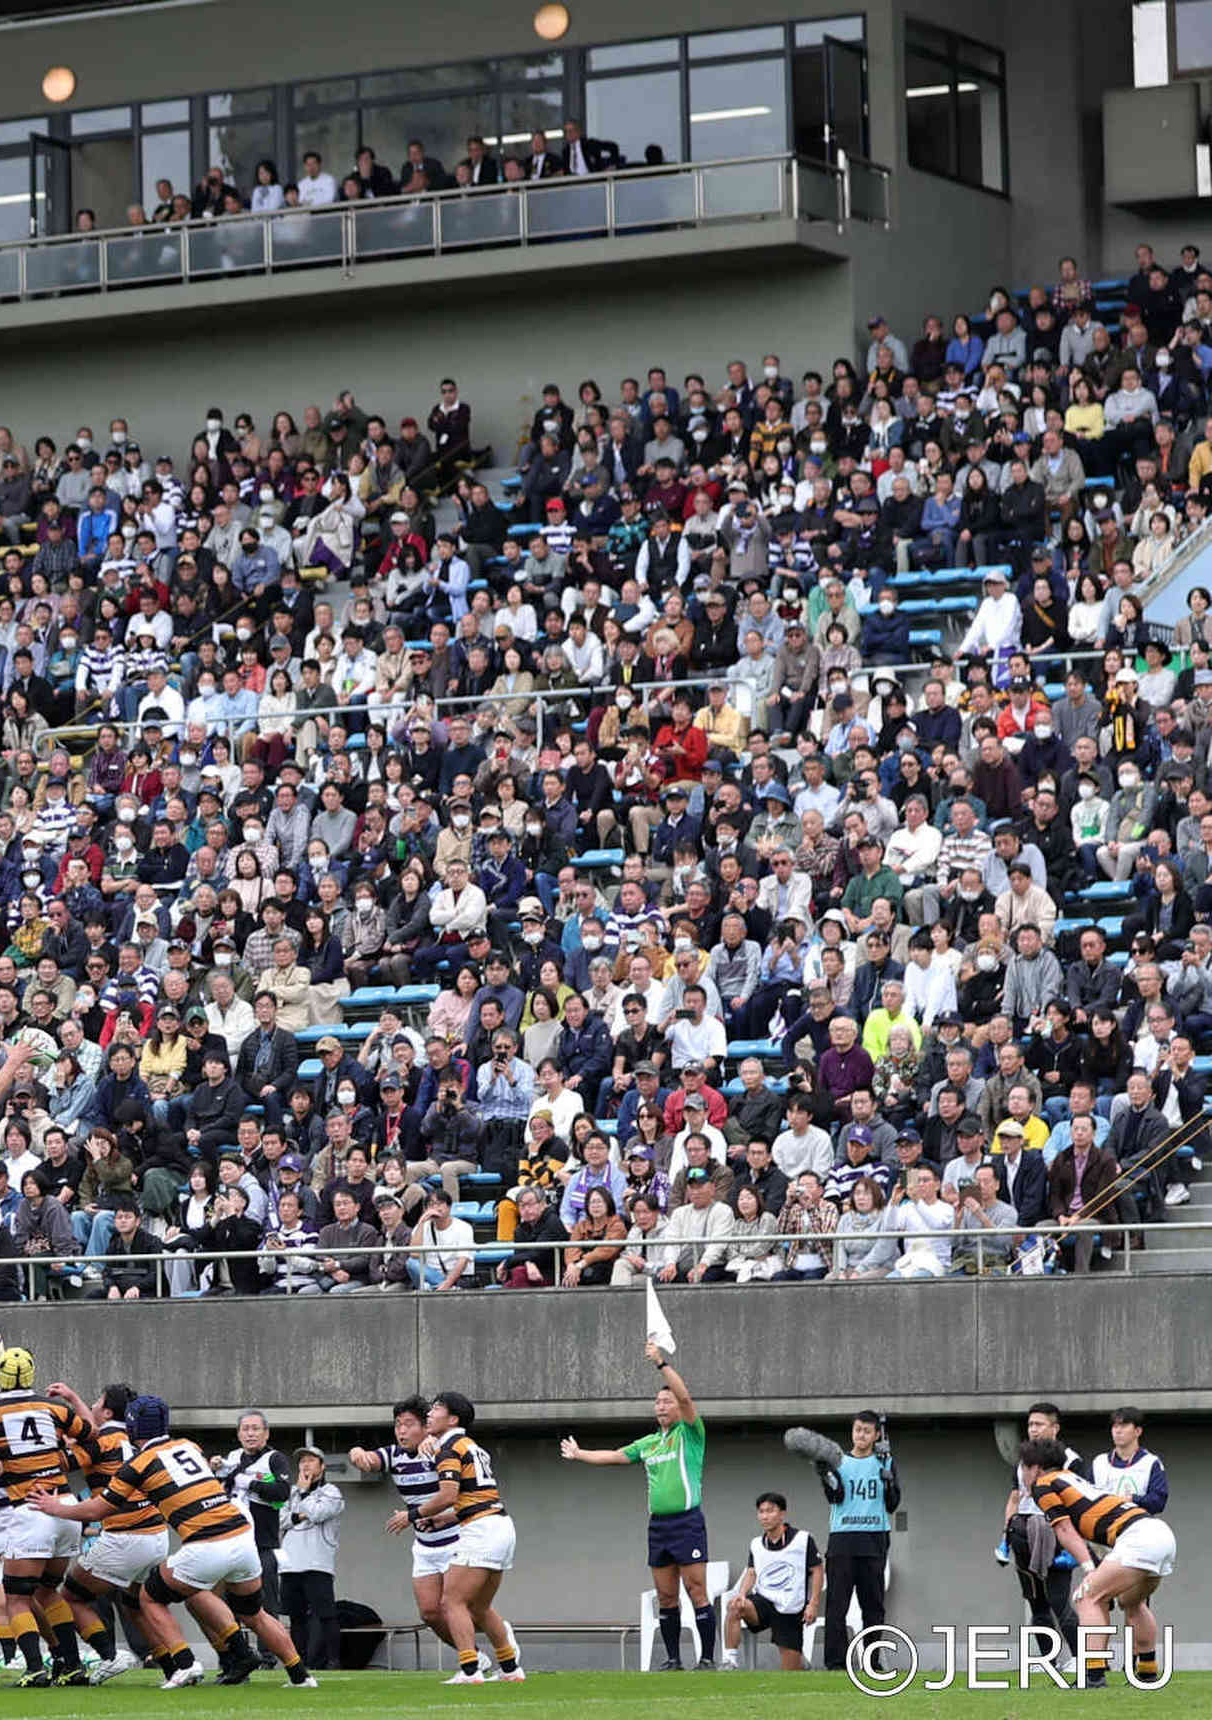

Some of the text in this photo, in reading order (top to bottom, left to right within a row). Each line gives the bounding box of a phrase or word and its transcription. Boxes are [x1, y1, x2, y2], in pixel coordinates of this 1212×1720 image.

[21, 1417, 45, 1445] 4
[172, 1450, 202, 1476] 5
[849, 1478, 877, 1501] 148
